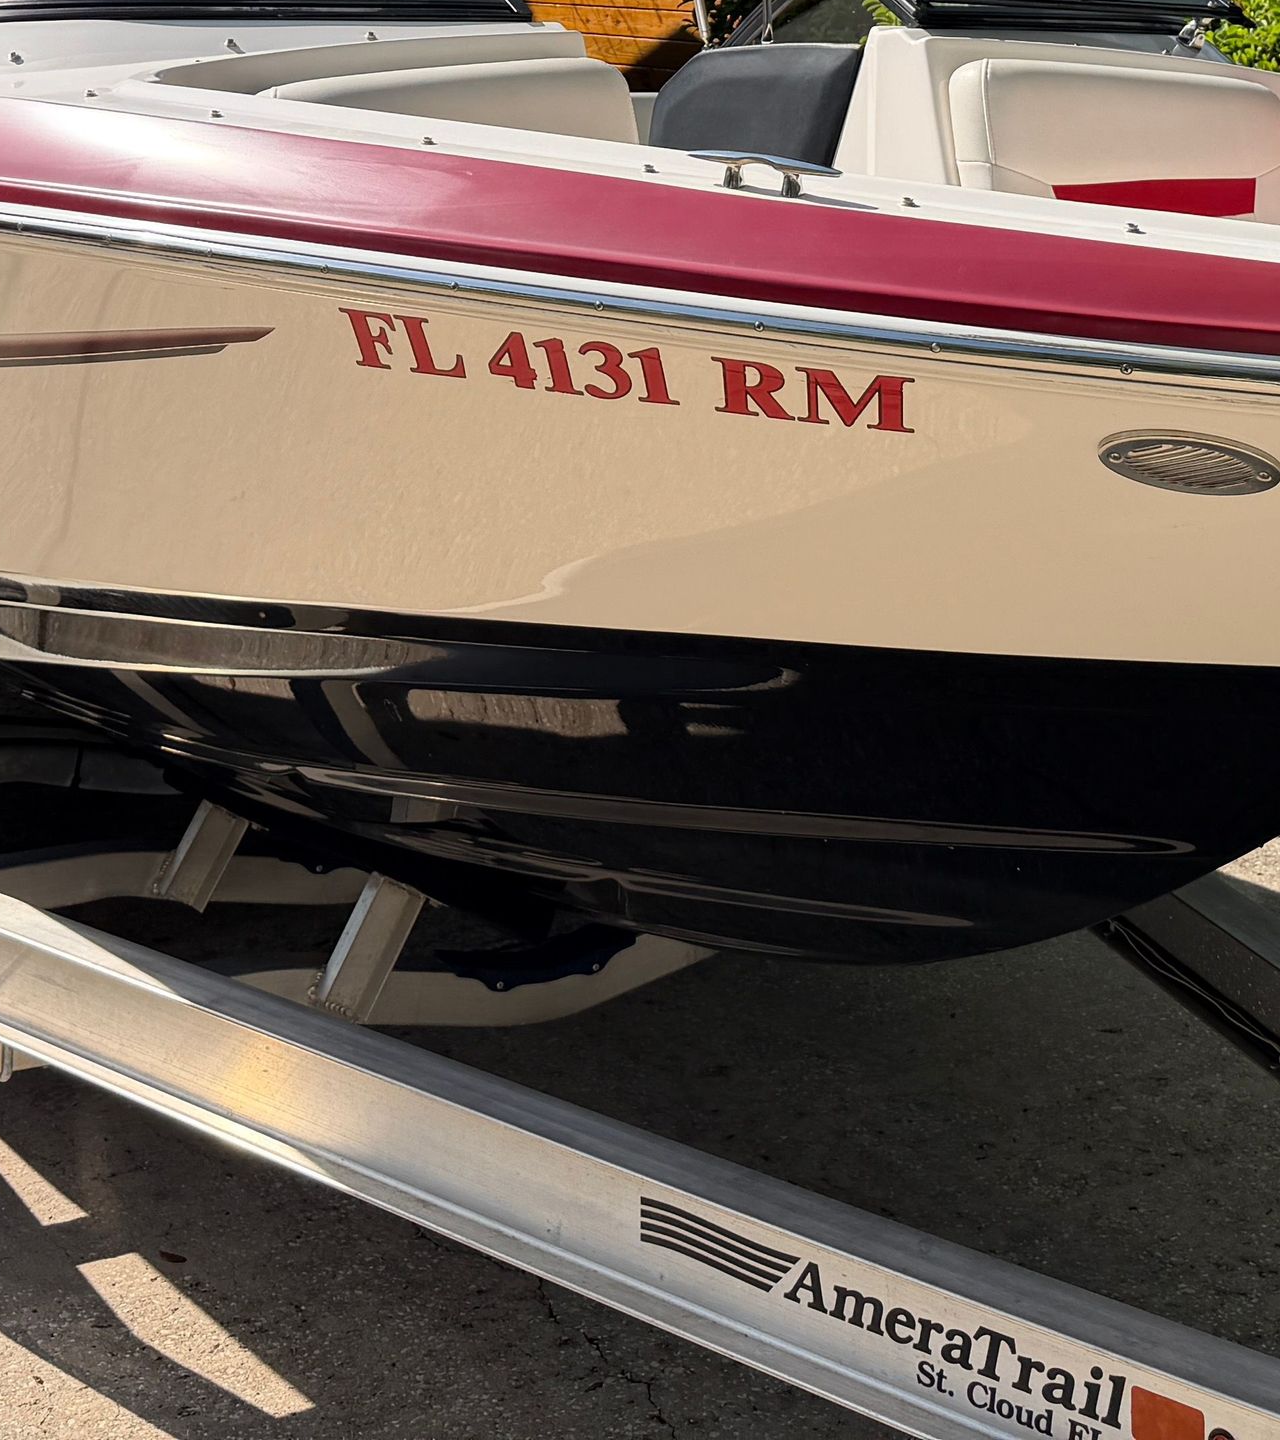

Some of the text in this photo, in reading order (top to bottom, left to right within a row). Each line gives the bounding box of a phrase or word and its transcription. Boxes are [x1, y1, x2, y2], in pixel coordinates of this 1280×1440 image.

[338, 307, 915, 433] FL 4131 RM
[783, 1260, 1126, 1430] AmeraTrail
[916, 1360, 955, 1397] St.
[966, 1378, 1053, 1437] Cloud
